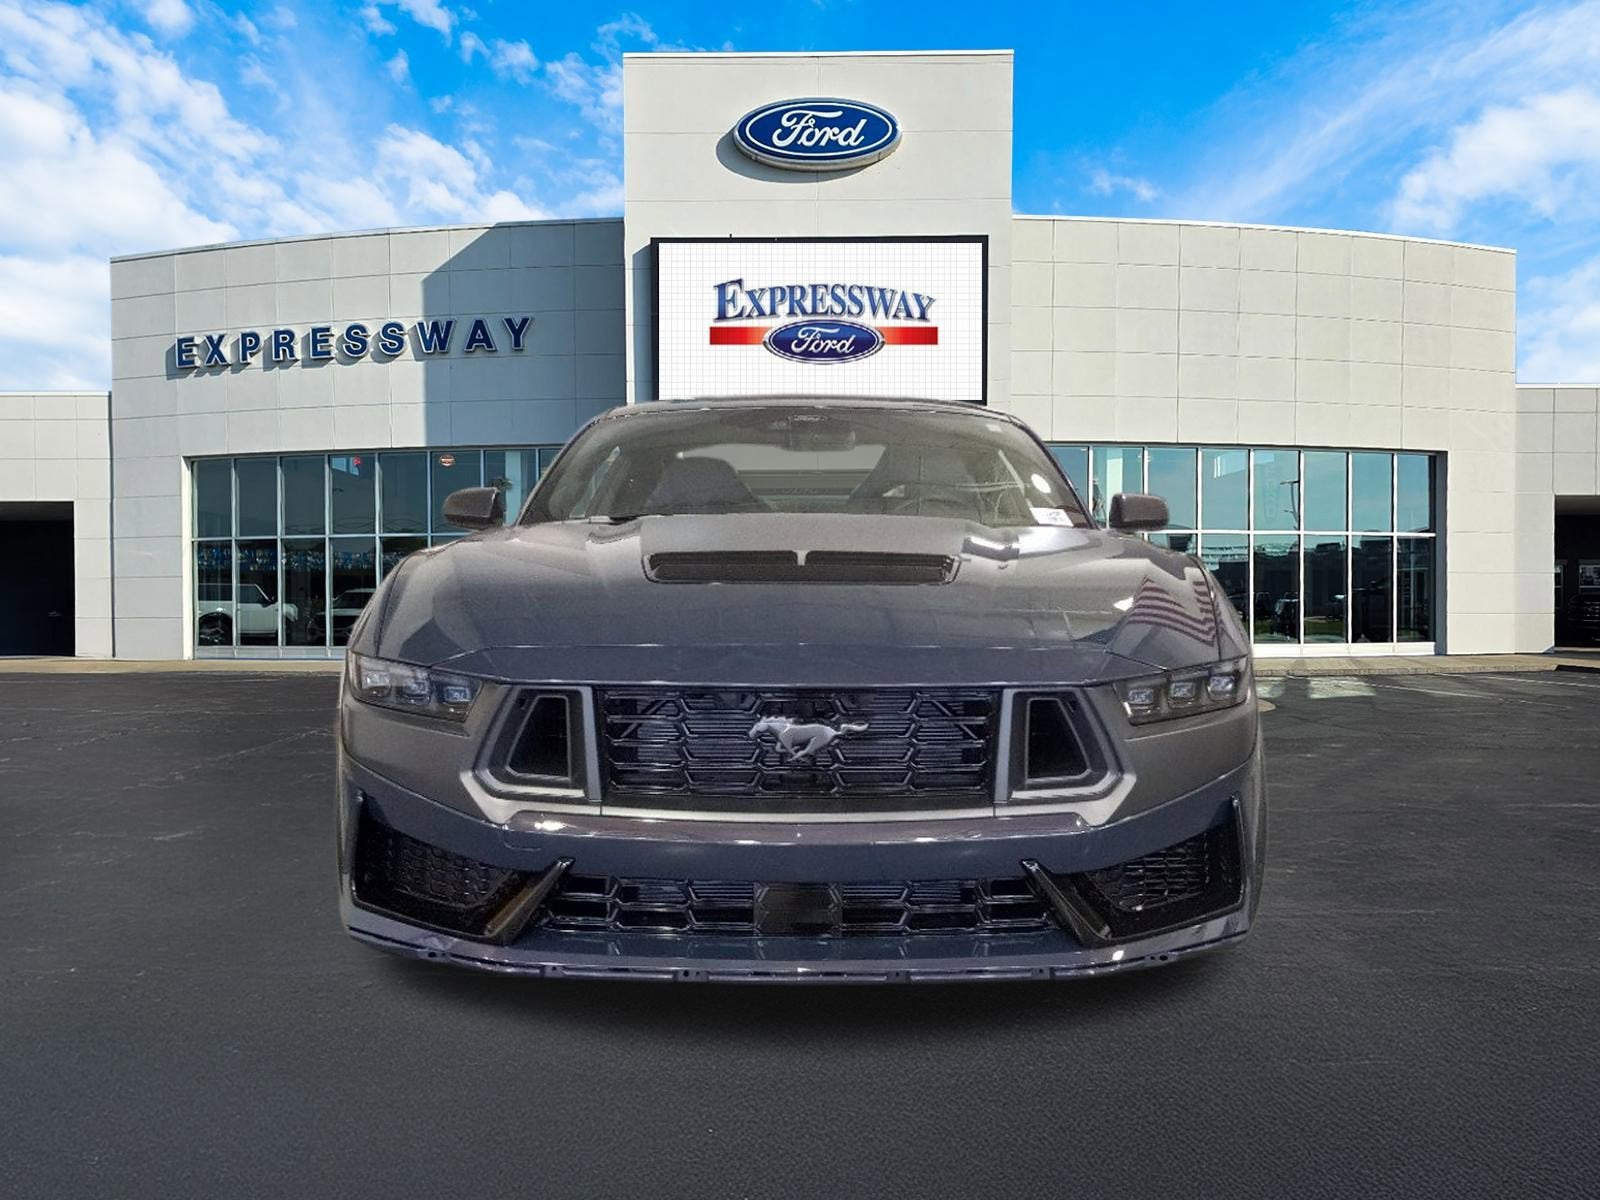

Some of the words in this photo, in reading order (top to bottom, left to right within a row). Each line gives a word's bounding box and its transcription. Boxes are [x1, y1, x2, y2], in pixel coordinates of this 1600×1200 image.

[771, 109, 866, 148] Ford
[712, 278, 936, 323] EXPRESSWAY
[175, 314, 534, 369] EXPRESSWAY
[790, 326, 856, 355] Ford
